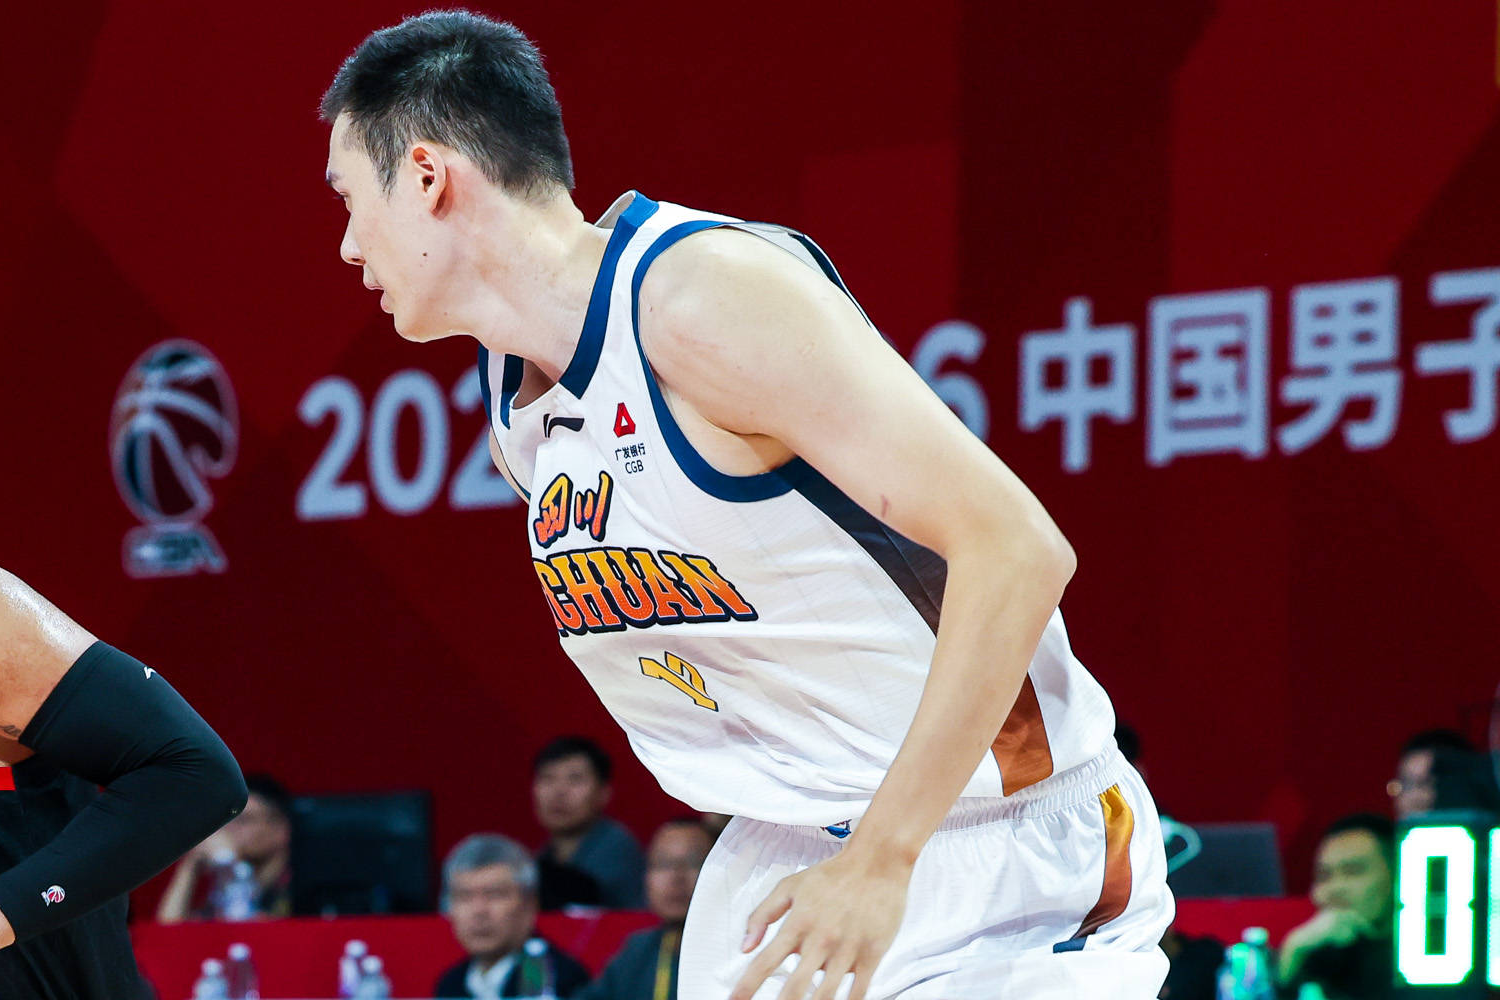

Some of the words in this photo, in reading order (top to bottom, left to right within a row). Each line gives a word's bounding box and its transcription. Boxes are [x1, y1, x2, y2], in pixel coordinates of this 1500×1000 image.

[1018, 268, 1500, 471] 中国男子
[615, 443, 646, 461] 广发银行
[625, 459, 644, 474] CGB
[532, 546, 759, 637] CHUAN
